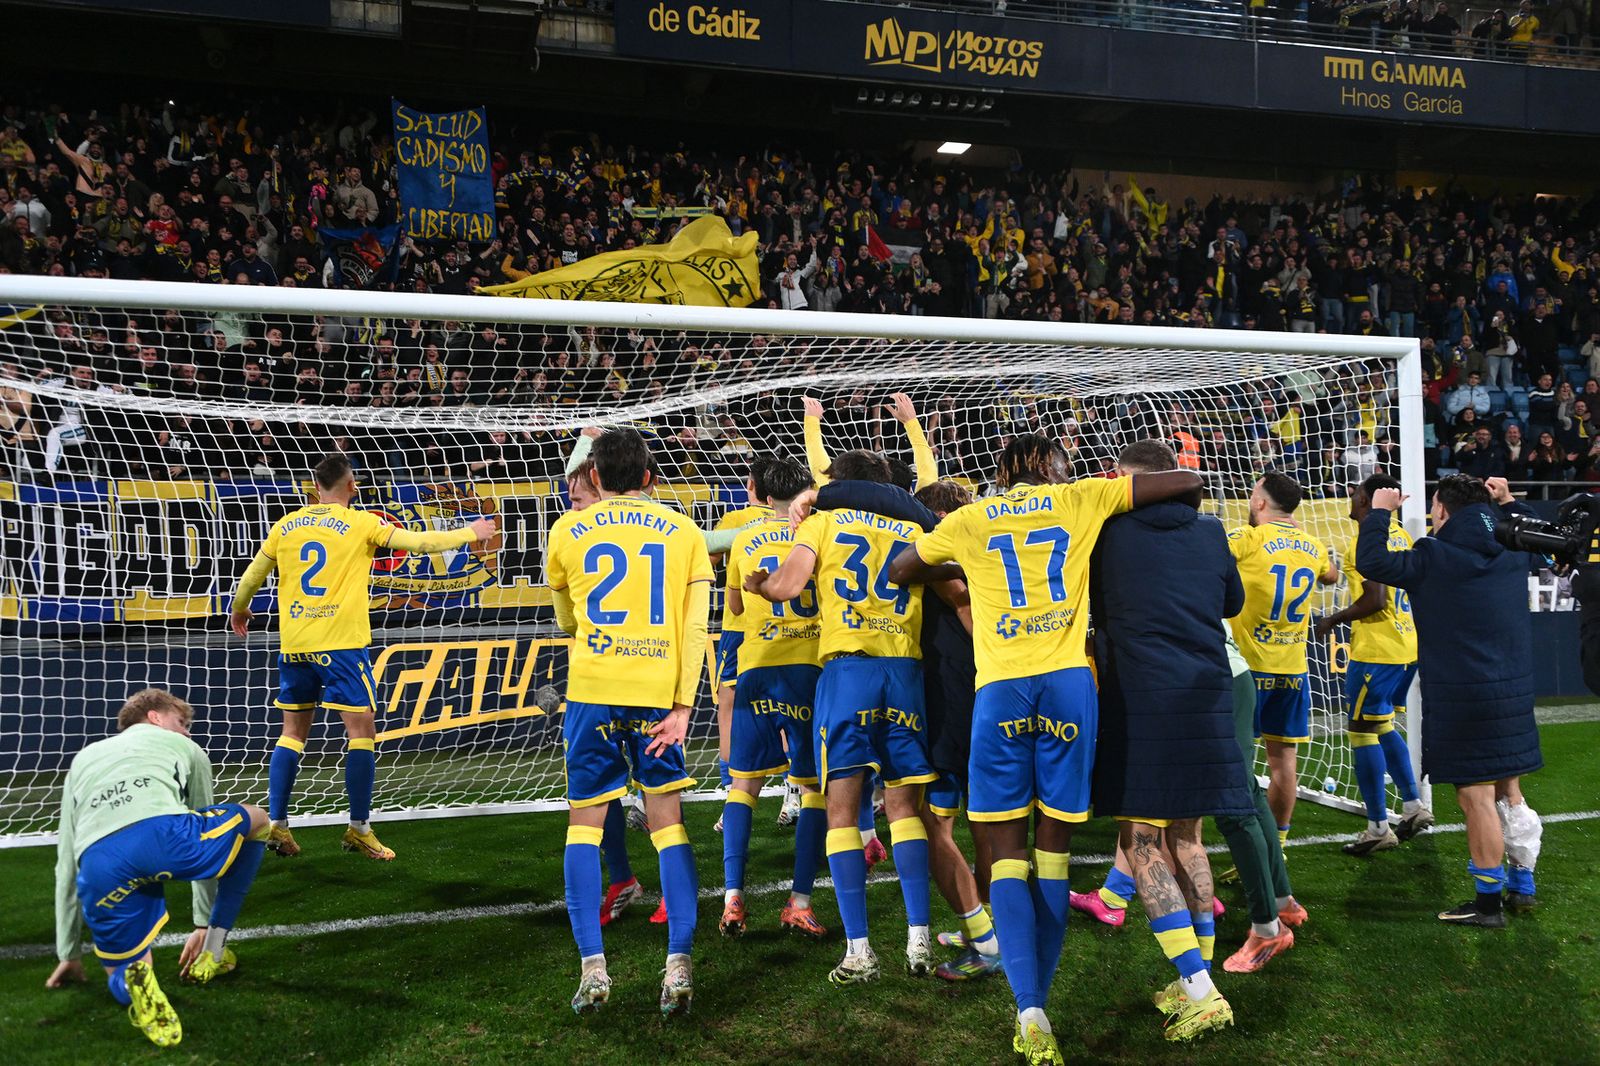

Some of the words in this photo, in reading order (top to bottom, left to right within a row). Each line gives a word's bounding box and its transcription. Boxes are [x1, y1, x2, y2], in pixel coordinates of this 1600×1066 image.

[648, 2, 680, 32] de
[687, 5, 761, 40] Cádiz
[945, 29, 1044, 60] MOTOS
[948, 50, 1040, 78] PAYAN
[1370, 60, 1467, 89] GAMMA
[1341, 86, 1392, 110] Hnos
[1403, 91, 1464, 115] García
[396, 105, 482, 140] SALUD
[396, 136, 487, 174] CADISMO
[407, 207, 493, 242] LIBERTAD
[986, 496, 1053, 521] DAWDA
[281, 516, 317, 537] JORGE
[570, 524, 593, 540] M.
[595, 512, 679, 537] CLIMENT
[835, 510, 874, 526] JUAN
[877, 517, 914, 539] DIAZ
[300, 541, 328, 597] 2
[833, 531, 912, 616] 34
[986, 526, 1071, 608] 17
[584, 542, 665, 625] 21
[1269, 563, 1315, 624] 12
[614, 646, 669, 660] PASCUAL
[616, 636, 671, 648] Hospitales
[751, 698, 812, 722] TELENO
[856, 707, 922, 732] TEENO
[998, 714, 1080, 743] TELENO
